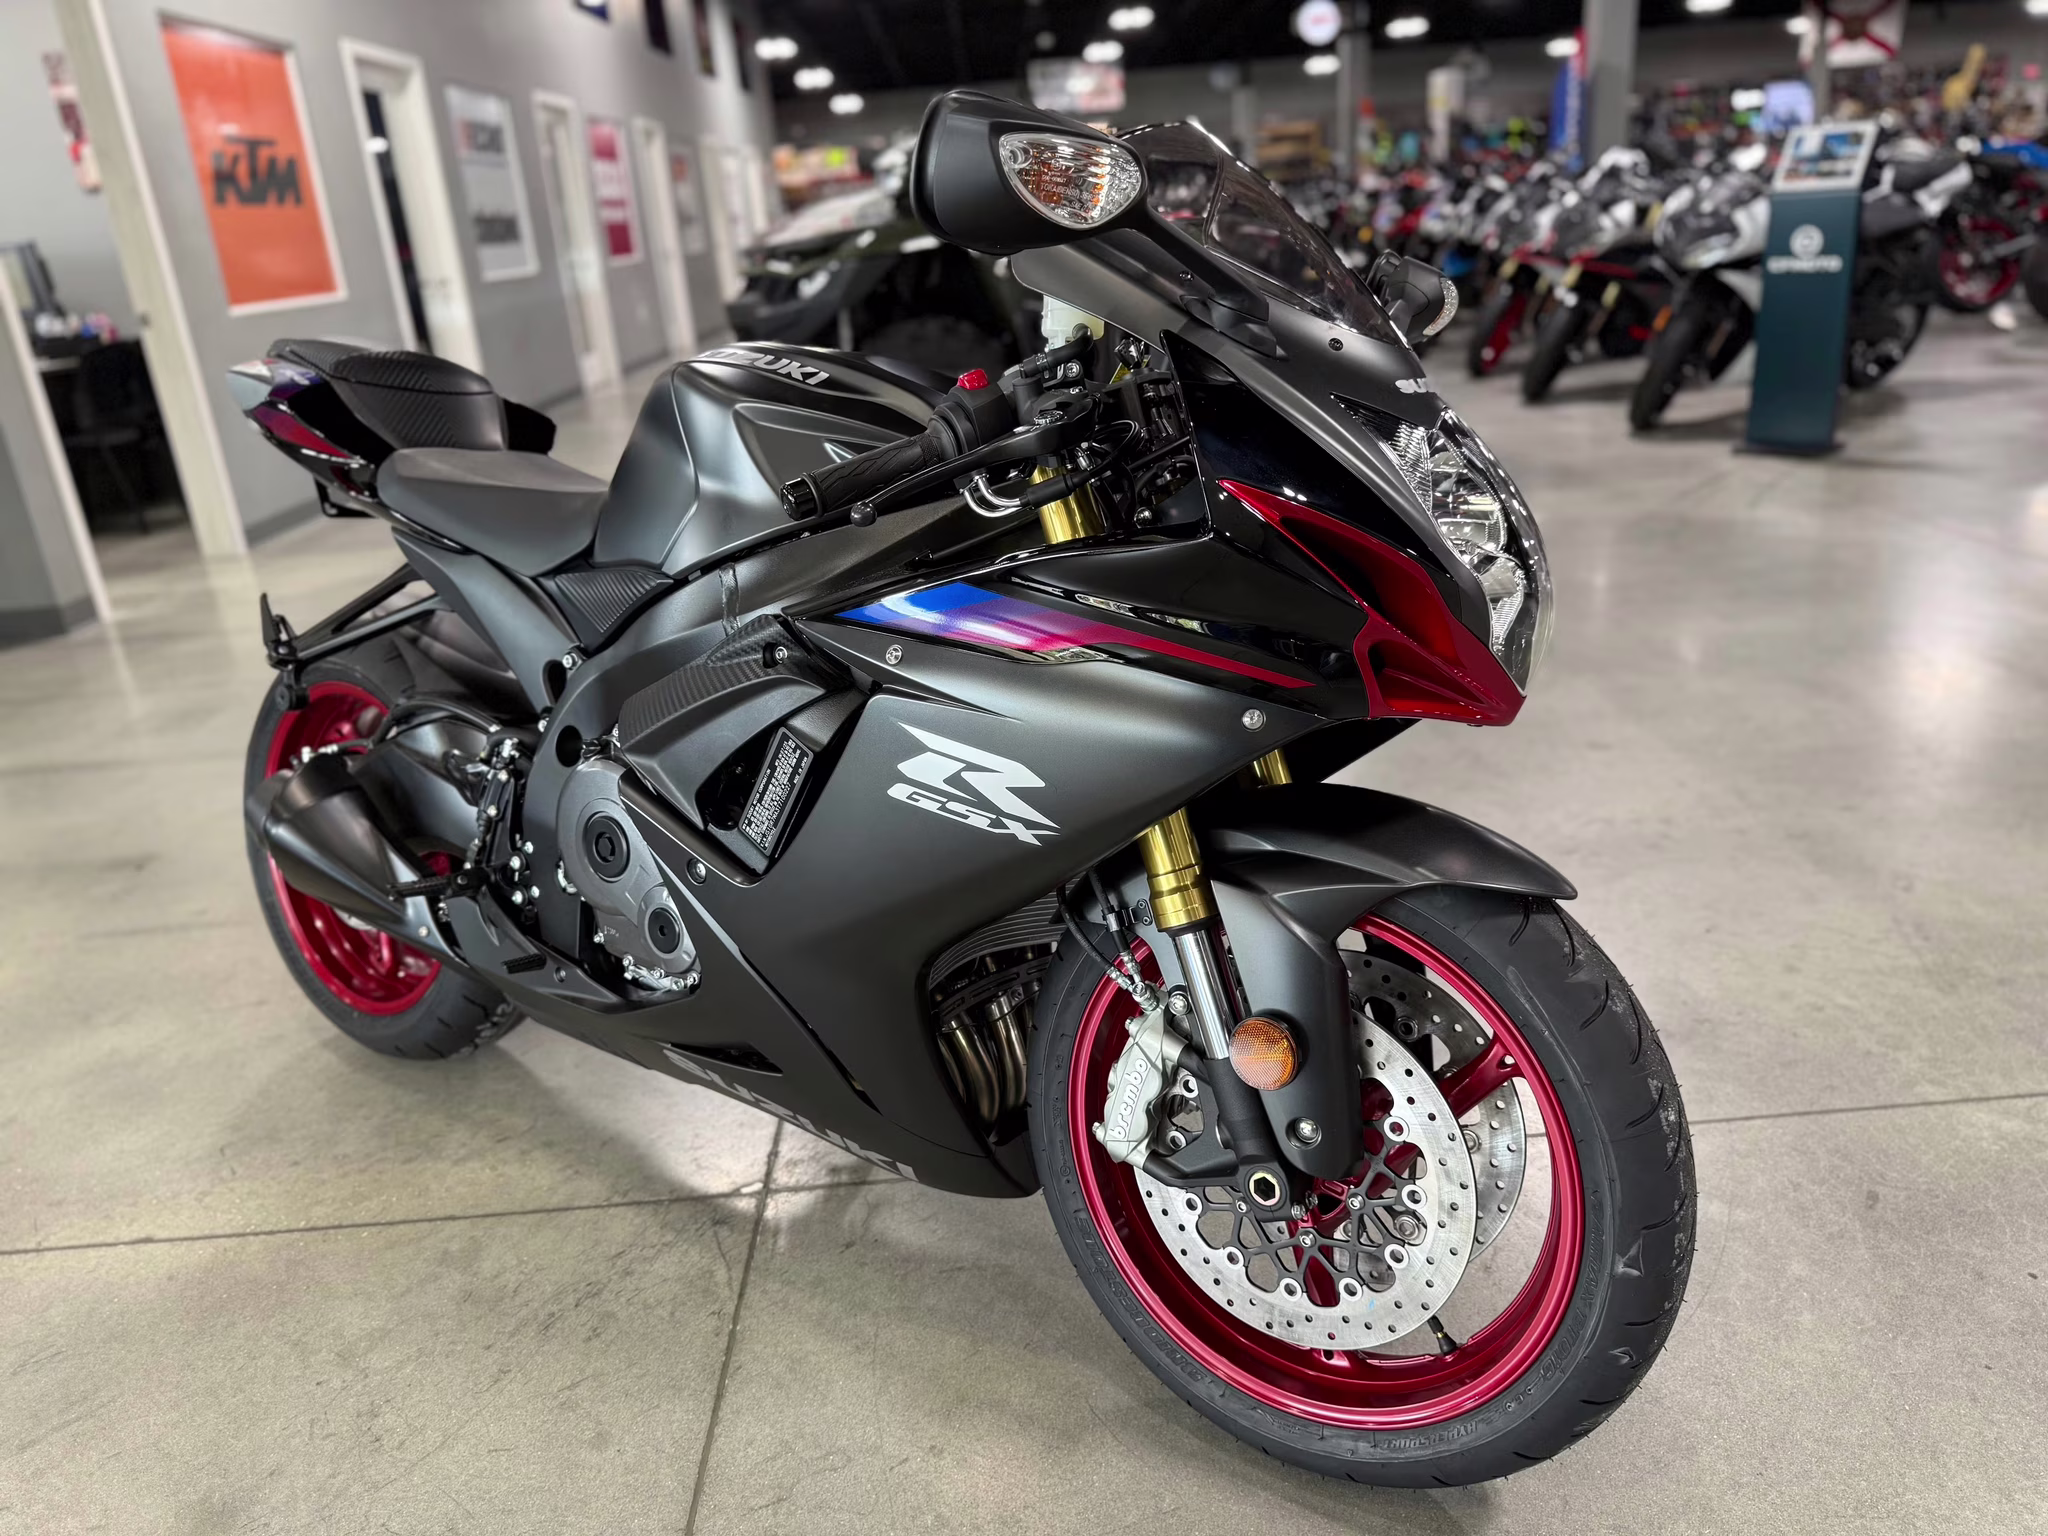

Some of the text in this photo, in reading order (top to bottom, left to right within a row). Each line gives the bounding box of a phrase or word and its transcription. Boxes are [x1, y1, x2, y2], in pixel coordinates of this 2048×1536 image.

[212, 136, 303, 207] KTM
[887, 782, 1061, 846] GSX
[1110, 1058, 1148, 1139] brembo
